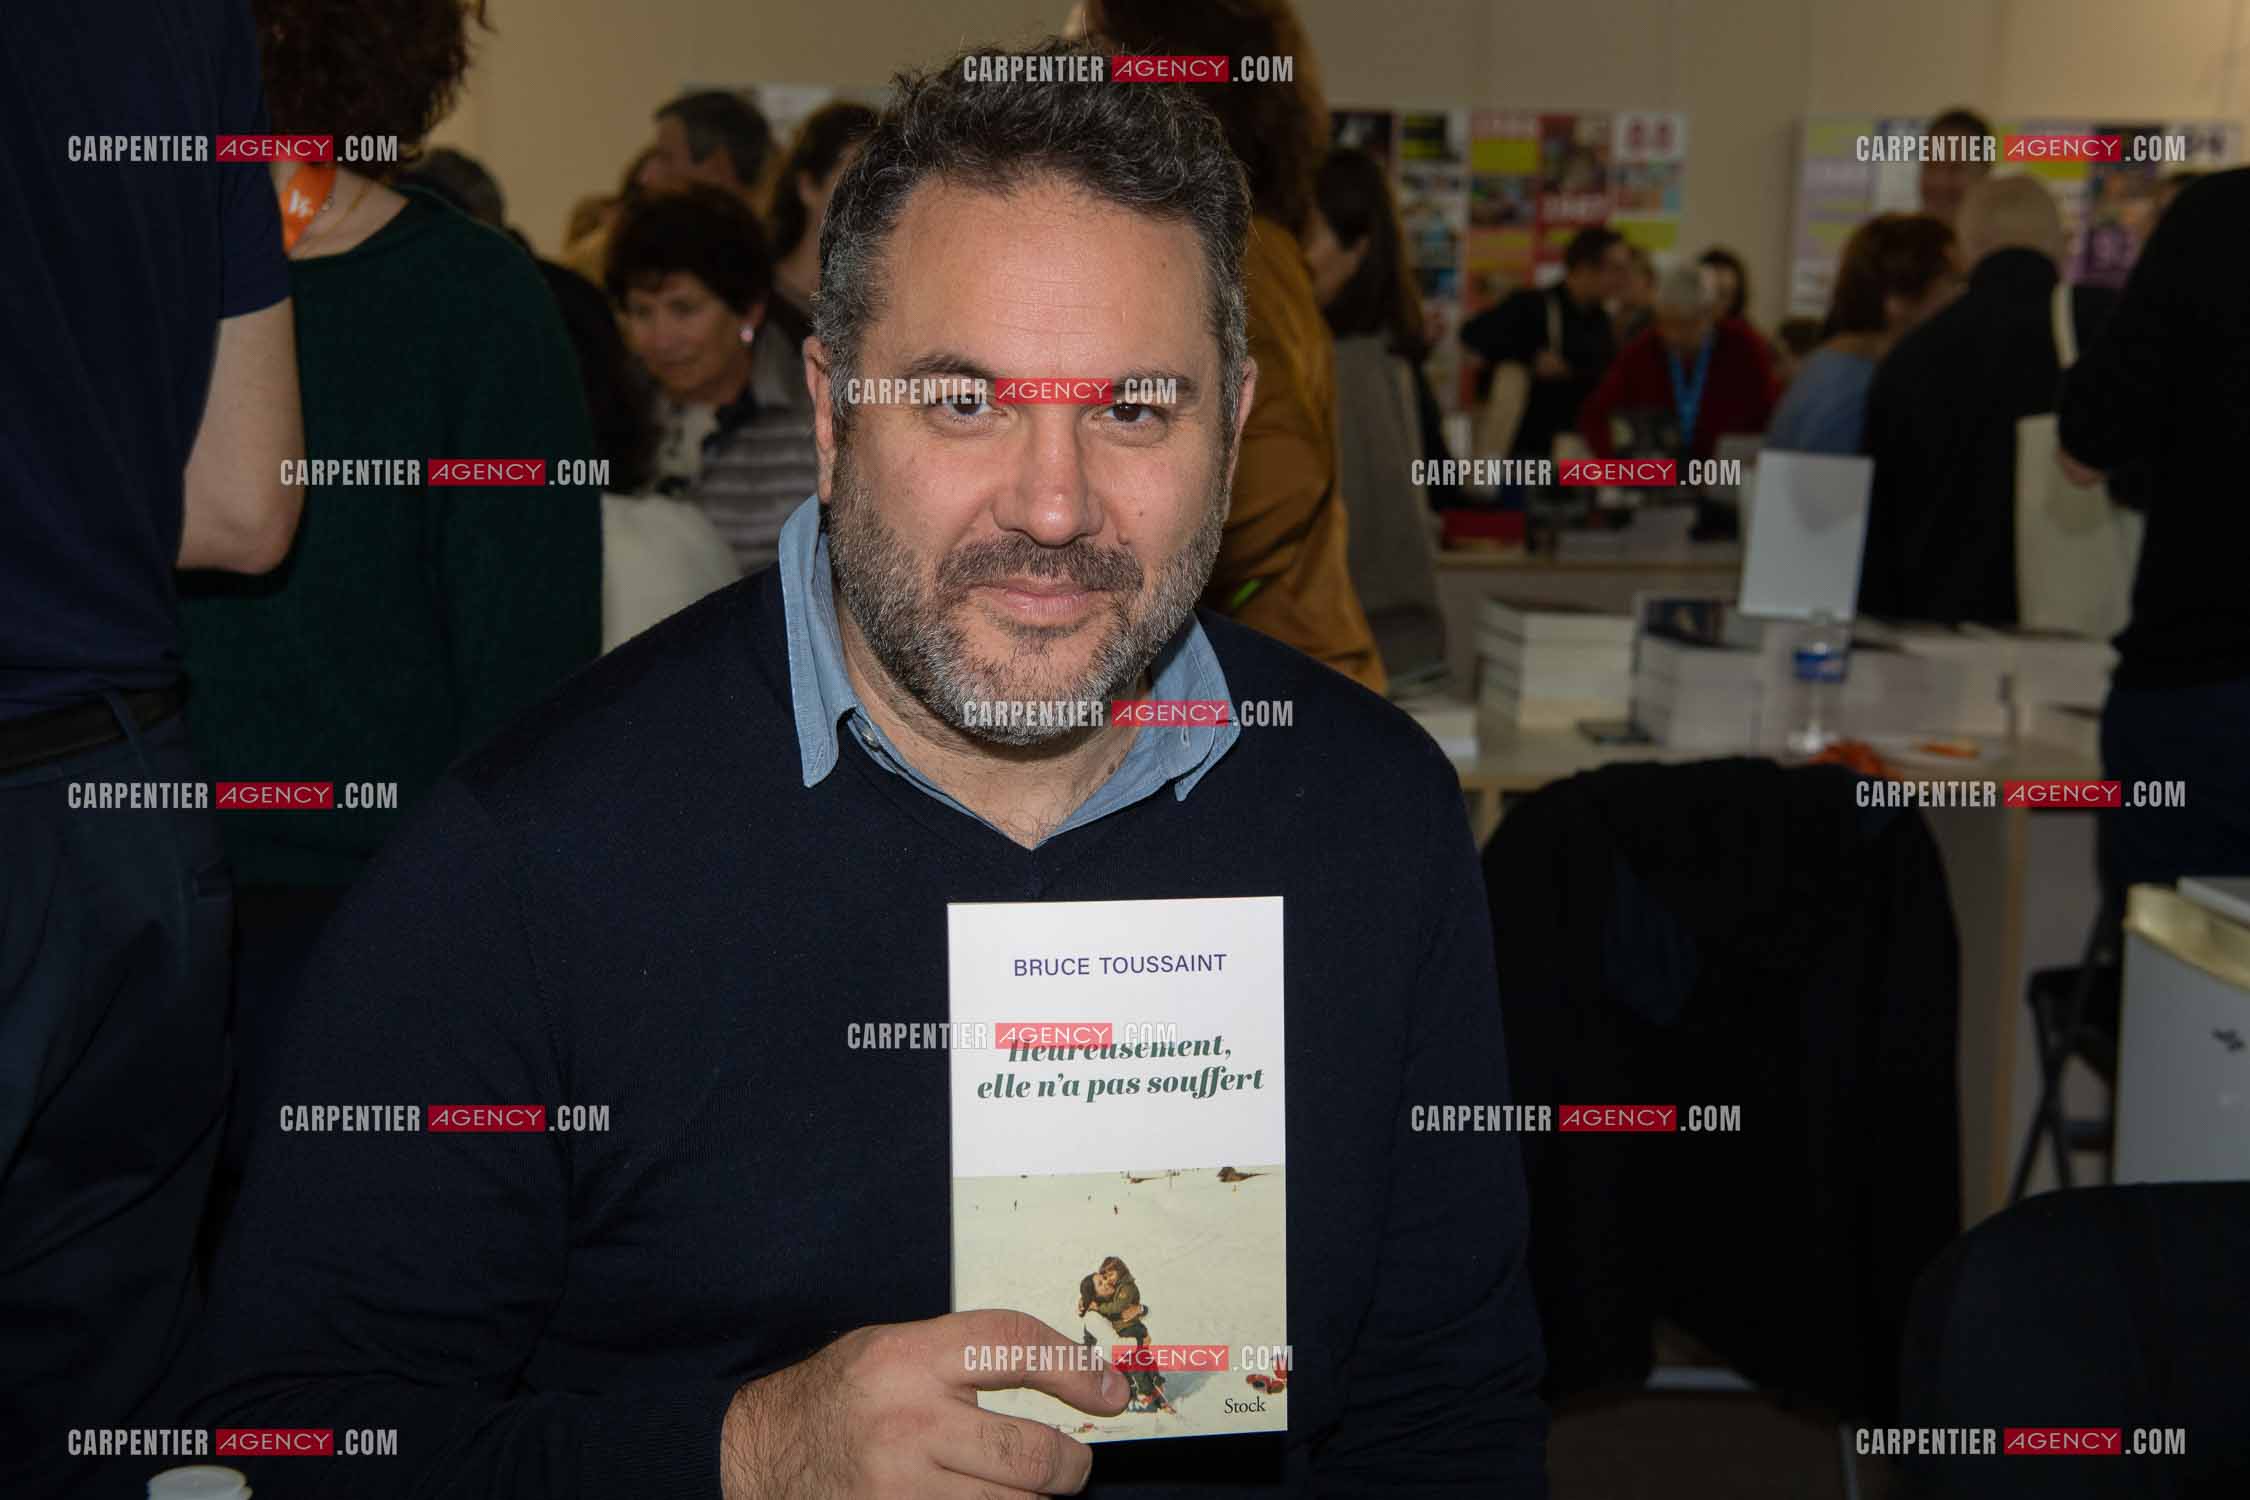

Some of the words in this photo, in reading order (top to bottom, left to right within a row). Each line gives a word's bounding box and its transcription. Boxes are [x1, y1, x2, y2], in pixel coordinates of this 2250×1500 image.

[1013, 957, 1090, 977] BRUCE
[1099, 953, 1228, 975] TOUSSAINT
[1007, 1034, 1232, 1063] Heureusement,
[977, 1073, 1033, 1099] elle
[1086, 1078, 1140, 1103] pas
[1146, 1065, 1265, 1100] souffert
[1223, 1395, 1266, 1415] Stock
